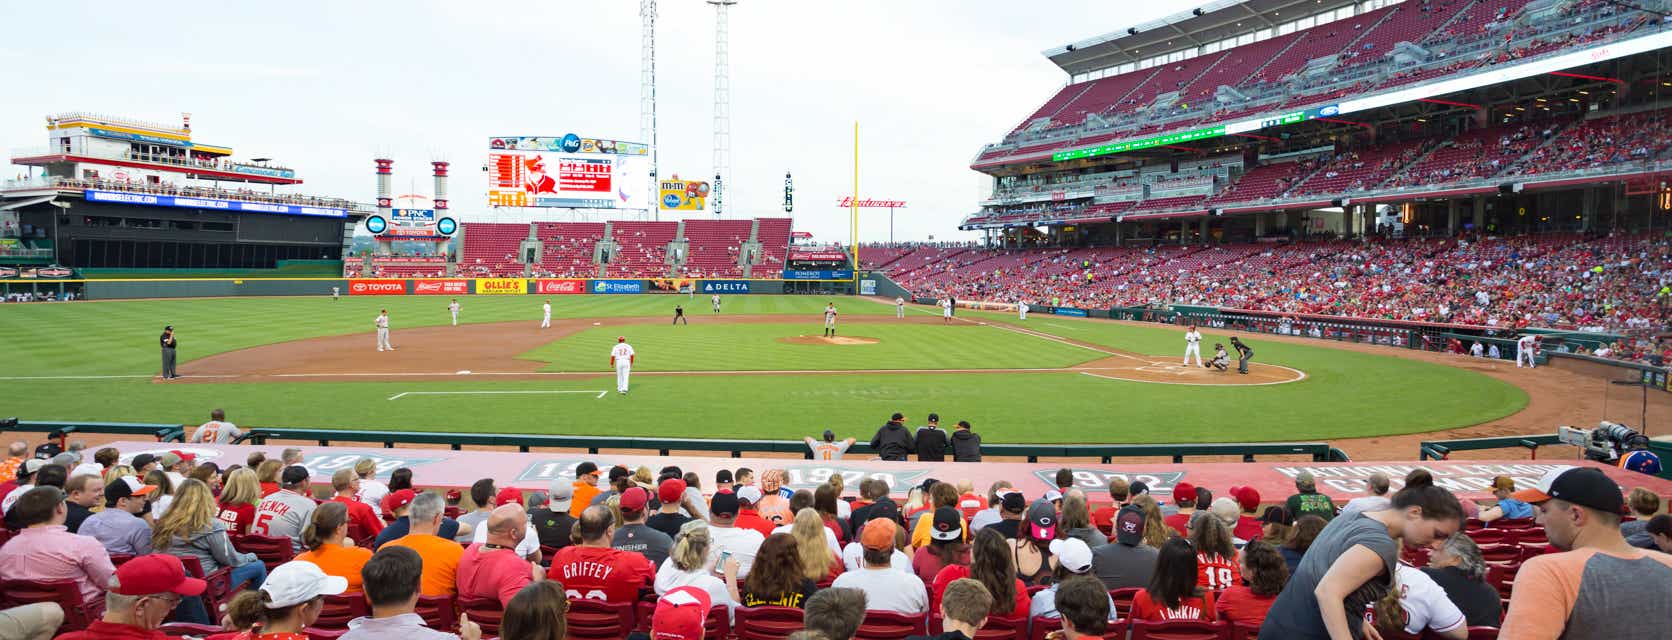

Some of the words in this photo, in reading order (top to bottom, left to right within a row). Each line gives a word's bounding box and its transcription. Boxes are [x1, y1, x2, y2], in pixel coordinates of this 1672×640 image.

[203, 430, 218, 443] 21
[823, 450, 832, 462] 11
[259, 500, 290, 516] BENCH
[257, 513, 273, 537] 5
[614, 543, 648, 551] NISHER
[563, 561, 613, 580] GRIFFEY
